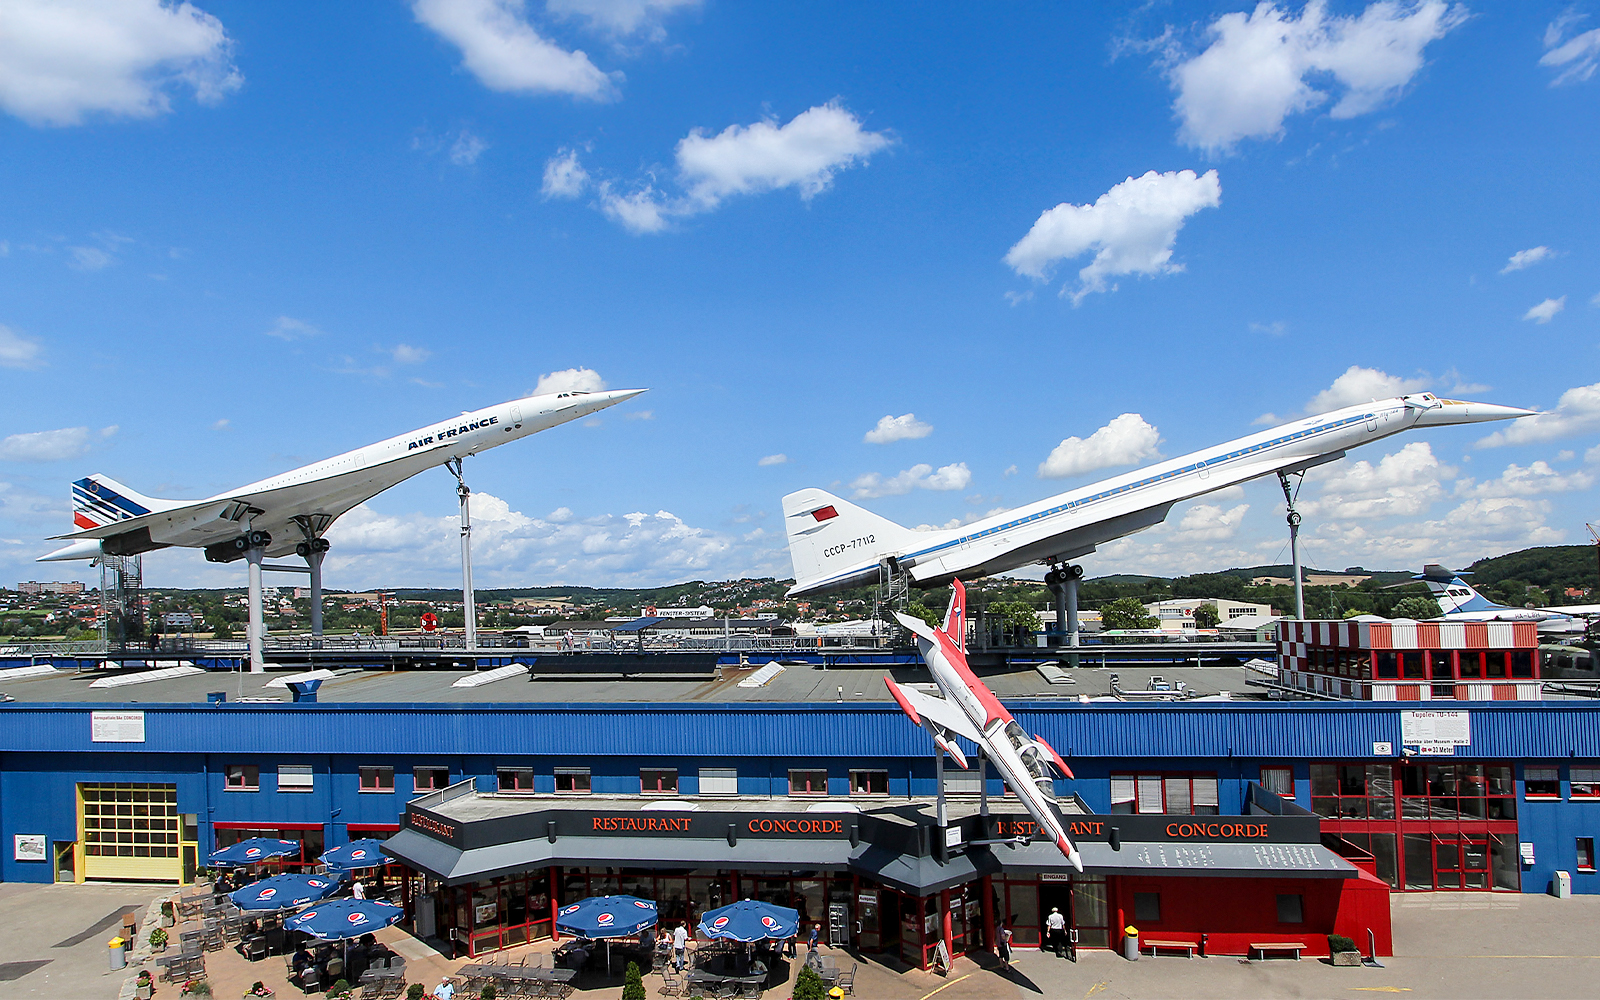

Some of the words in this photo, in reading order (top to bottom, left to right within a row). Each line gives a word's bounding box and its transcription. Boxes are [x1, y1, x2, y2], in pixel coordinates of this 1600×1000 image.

[408, 436, 434, 450] AIR
[437, 416, 499, 440] FRANCE
[1411, 711, 1434, 719] Tupolev
[592, 817, 692, 831] RESTAURANT
[748, 818, 843, 833] CONCORDE
[1166, 822, 1268, 838] CONCORDE
